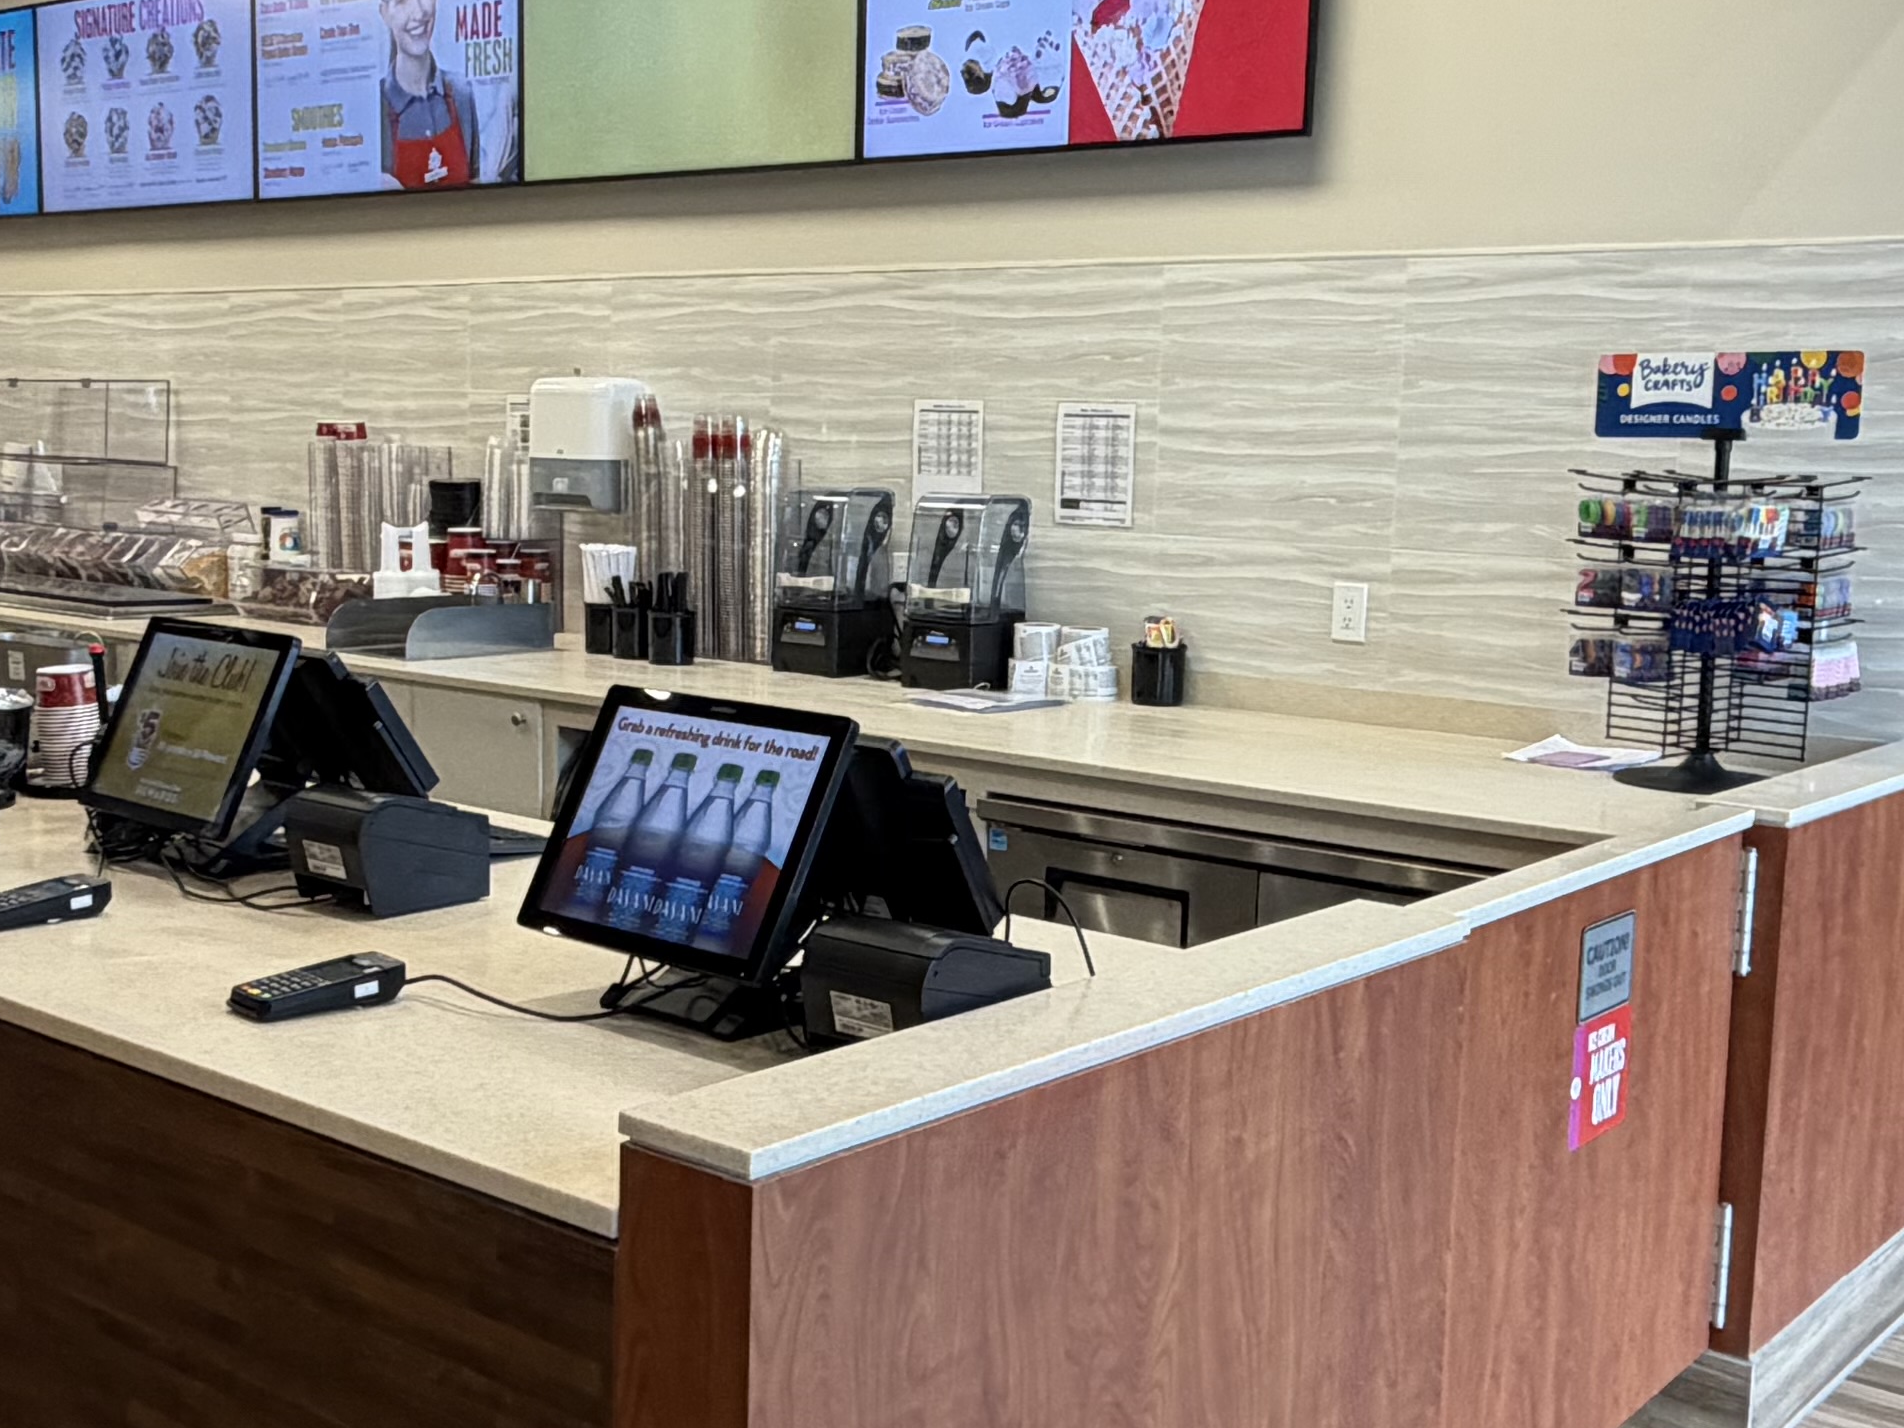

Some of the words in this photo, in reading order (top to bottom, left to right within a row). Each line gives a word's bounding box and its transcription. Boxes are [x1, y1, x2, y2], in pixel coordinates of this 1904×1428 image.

[74, 0, 136, 39] SIGNATURE
[455, 0, 503, 43] MADE
[465, 38, 513, 78] FRESH
[1638, 358, 1711, 389] Bakery
[1644, 377, 1693, 392] CRAFTS
[1619, 413, 1670, 425] DESIGNER
[1672, 413, 1720, 425] CANDLES
[618, 717, 644, 734] Grab
[645, 726, 653, 735] a
[654, 723, 711, 748] refreshing
[712, 730, 742, 750] drink
[743, 735, 762, 752] for
[764, 740, 784, 756] the
[785, 746, 820, 761] road!
